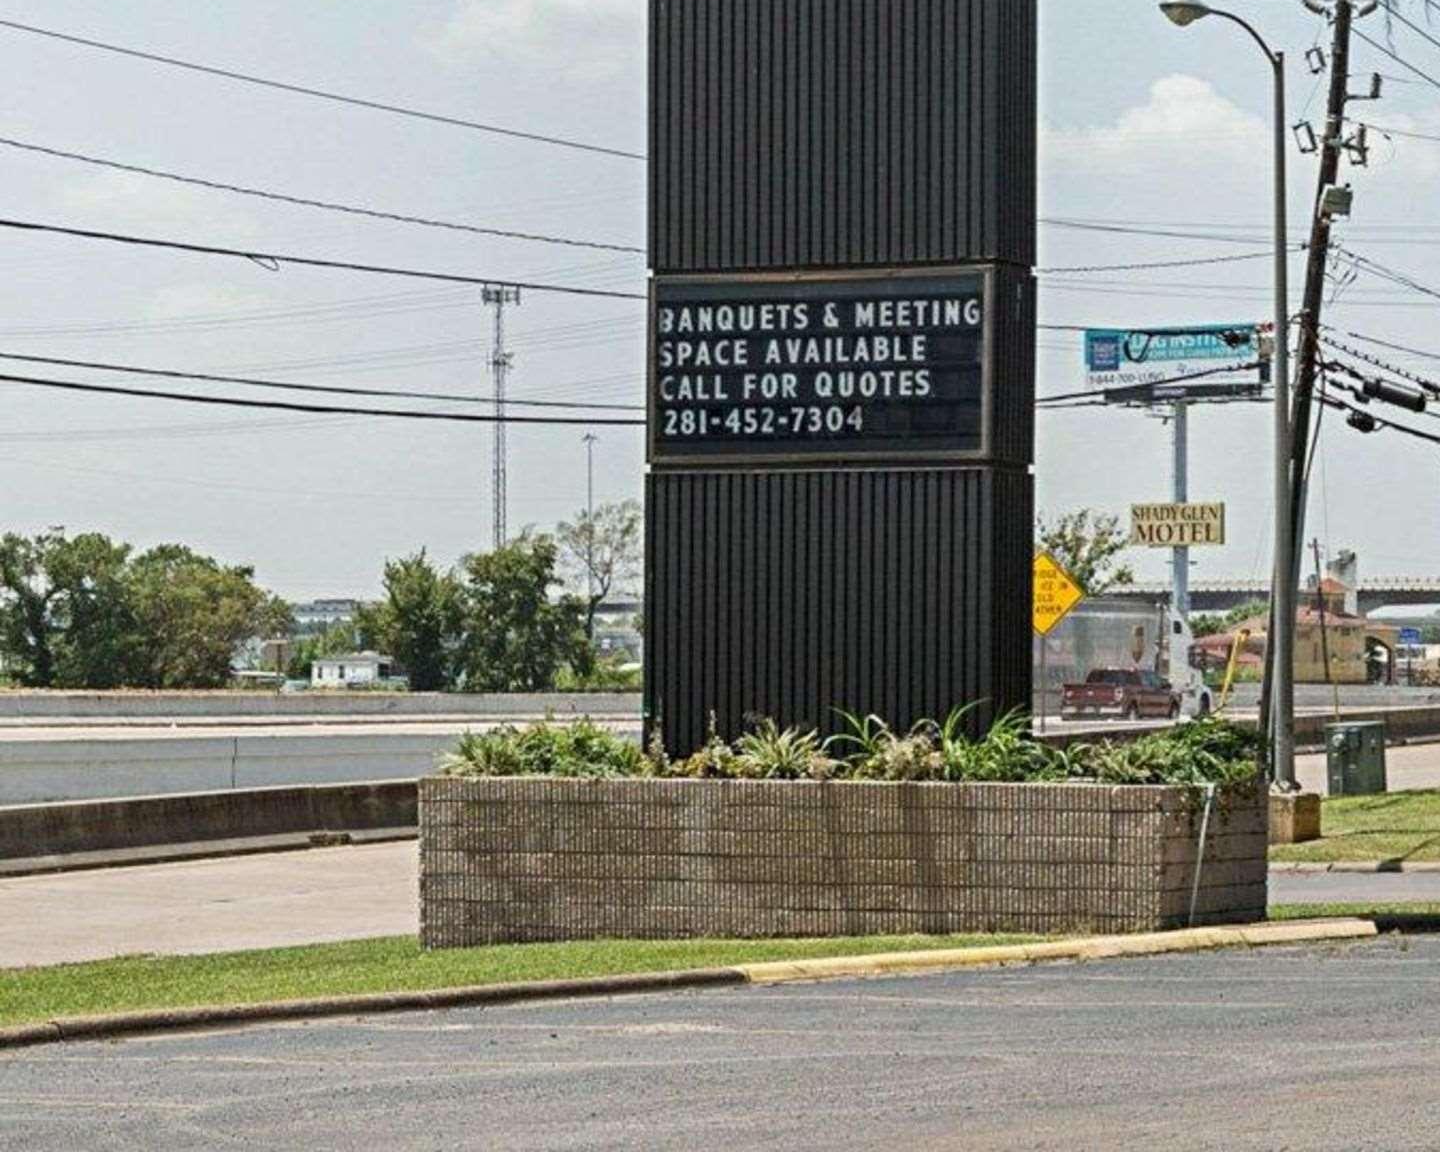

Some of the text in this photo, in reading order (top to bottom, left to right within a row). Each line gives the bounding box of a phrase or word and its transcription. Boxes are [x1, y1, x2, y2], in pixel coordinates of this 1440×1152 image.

[659, 298, 981, 333] BANQUETS & MEETING
[660, 335, 926, 367] SPACE AVAILABLE
[660, 369, 931, 401] CALL FOR QUOTES
[664, 405, 864, 436] 281-452-7304
[1132, 504, 1218, 521] SHADY GLEN
[1136, 522, 1216, 542] MOTEL
